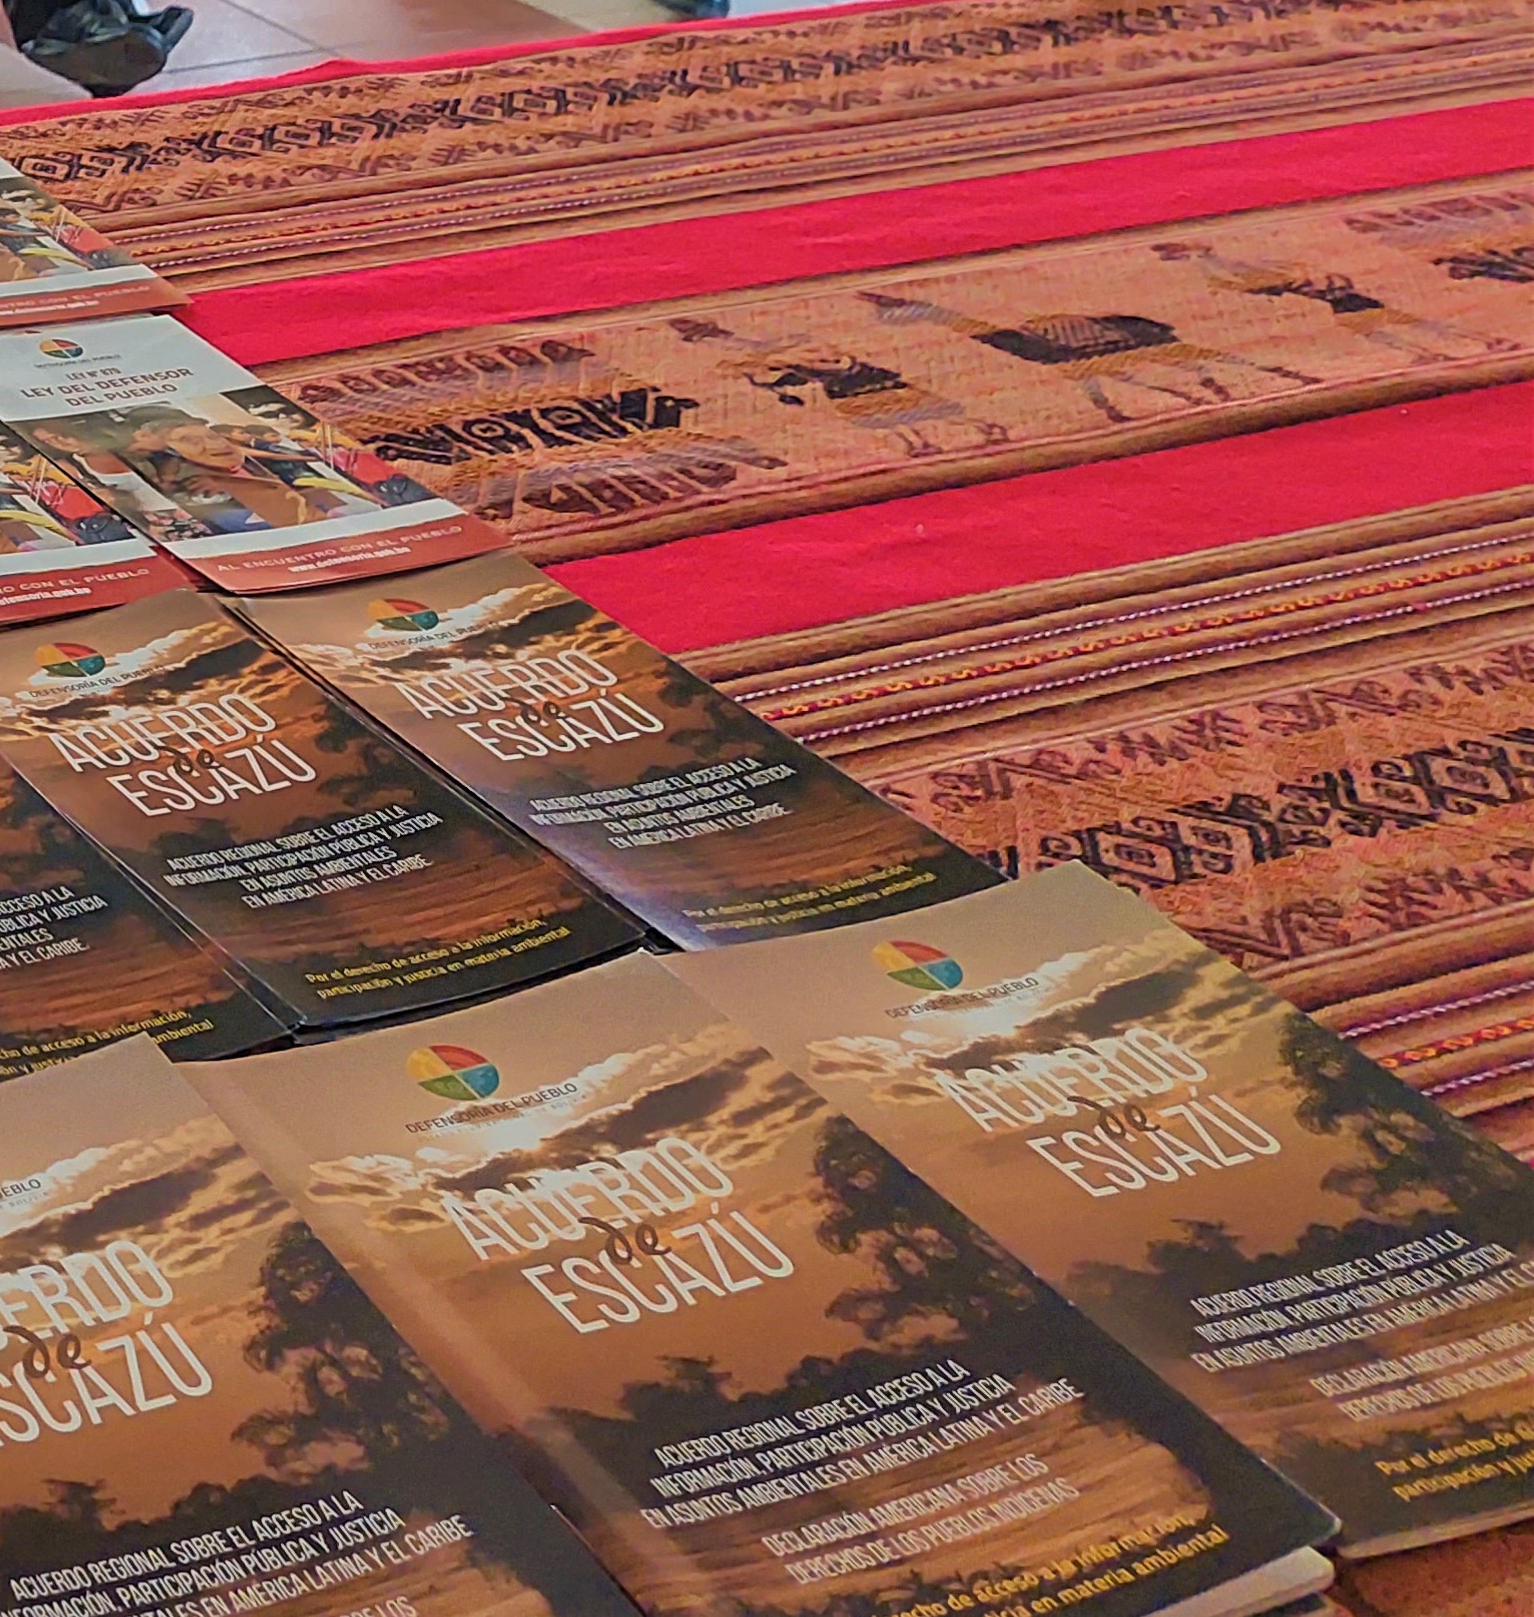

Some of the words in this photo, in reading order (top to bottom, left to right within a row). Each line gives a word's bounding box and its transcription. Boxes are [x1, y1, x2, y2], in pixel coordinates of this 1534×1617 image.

[20, 387, 52, 397] LEY
[57, 384, 94, 394] DEL
[94, 370, 194, 387] DEFENSOR
[65, 396, 102, 405] DEL
[104, 385, 176, 398] PUEBLO
[20, 580, 54, 589] CON
[82, 570, 150, 581] PUEBLO
[404, 649, 618, 718] ACUERDO
[56, 693, 277, 772] ACUERDO
[458, 685, 662, 762] ESCAZÚ
[106, 732, 316, 818] ESCAZÚ
[959, 989, 991, 1002] DEL
[984, 976, 1039, 996] PUEBLO
[491, 1100, 523, 1113] DEL
[518, 1082, 578, 1106] PUEBLO
[939, 1028, 1211, 1131] ACUERDO
[1026, 1085, 1283, 1198] ESCAZÚ
[444, 1139, 734, 1261] ACUERDO
[520, 1199, 796, 1334] ESCAZÚ
[578, 1220, 672, 1265] de
[3, 1327, 92, 1380] de
[926, 1368, 948, 1385] A
[935, 1359, 971, 1380] LA
[793, 1398, 855, 1429] SOBRE
[842, 1394, 876, 1414] EL
[863, 1405, 941, 1439] PÚBLICA
[925, 1397, 948, 1416] Y
[943, 1375, 1020, 1412] JUSTICIA
[865, 1372, 935, 1407] ACCESO
[640, 1508, 672, 1528] EN
[666, 1490, 742, 1528] ASUNTOS
[735, 1462, 847, 1510] AMBIENTALES
[836, 1457, 870, 1479] EN
[861, 1435, 941, 1472] AMÉRICA
[925, 1415, 995, 1448] LATINA
[982, 1410, 1005, 1429] Y
[995, 1404, 1031, 1424] EL
[1014, 1378, 1087, 1414] CARIBE
[654, 1432, 731, 1468] ACUERDO
[720, 1414, 807, 1450] REGIONAL
[868, 1484, 969, 1527] AMERICANA
[956, 1465, 1020, 1497] SOBRE
[1005, 1454, 1050, 1480] LOS
[10, 1563, 91, 1600] ACUERDO
[87, 1546, 176, 1583] REGIONAL
[170, 1531, 233, 1564] SOBRE
[226, 1526, 257, 1548] EL
[252, 1504, 322, 1541] ACCESO
[321, 1500, 339, 1520] A
[330, 1490, 365, 1514] LA
[786, 1546, 877, 1583] DERECHOS
[865, 1539, 900, 1562] DE
[887, 1530, 931, 1556] LOS
[918, 1508, 1001, 1545] PUEBLOS
